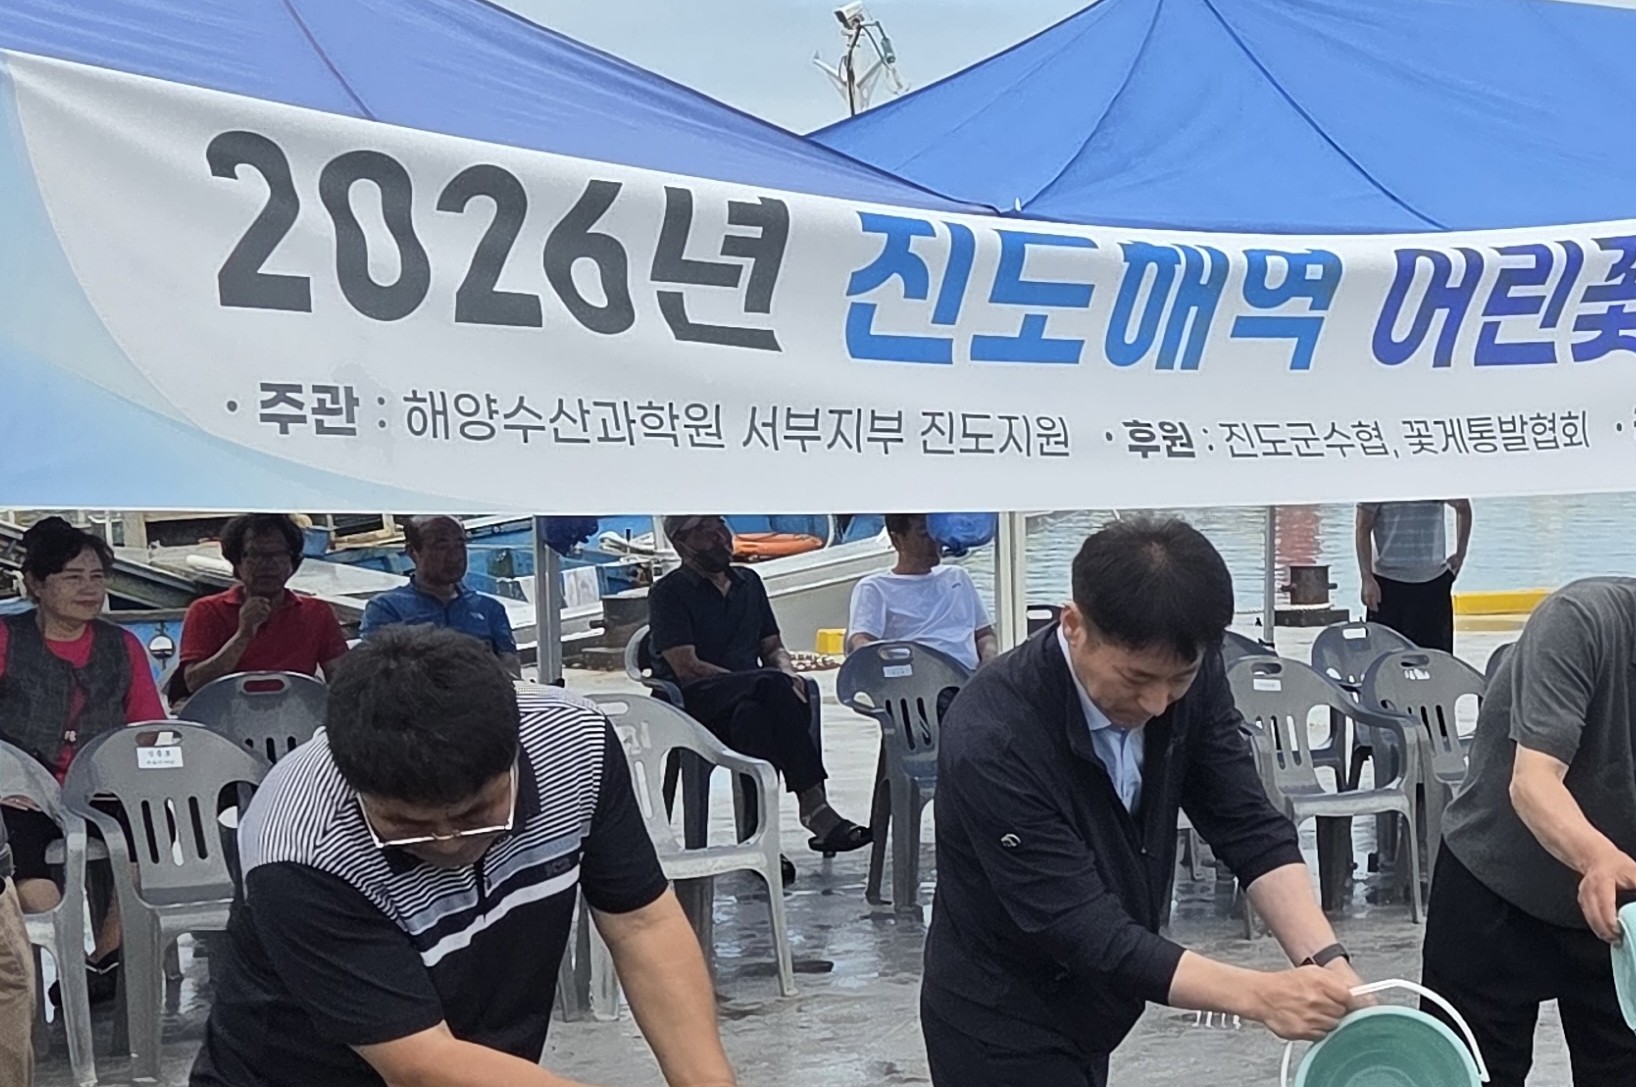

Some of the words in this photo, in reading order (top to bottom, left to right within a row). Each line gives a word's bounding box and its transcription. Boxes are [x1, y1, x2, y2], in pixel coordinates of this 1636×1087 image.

[205, 130, 791, 353] 2026년
[845, 211, 1343, 371] 진도해역
[402, 389, 725, 449] 해양수산과학원
[742, 405, 904, 455] 서부지부
[920, 411, 1070, 457] 진도지원
[1219, 420, 1399, 459] 진도군수협,
[1401, 410, 1590, 455] 꽃게통발협회
